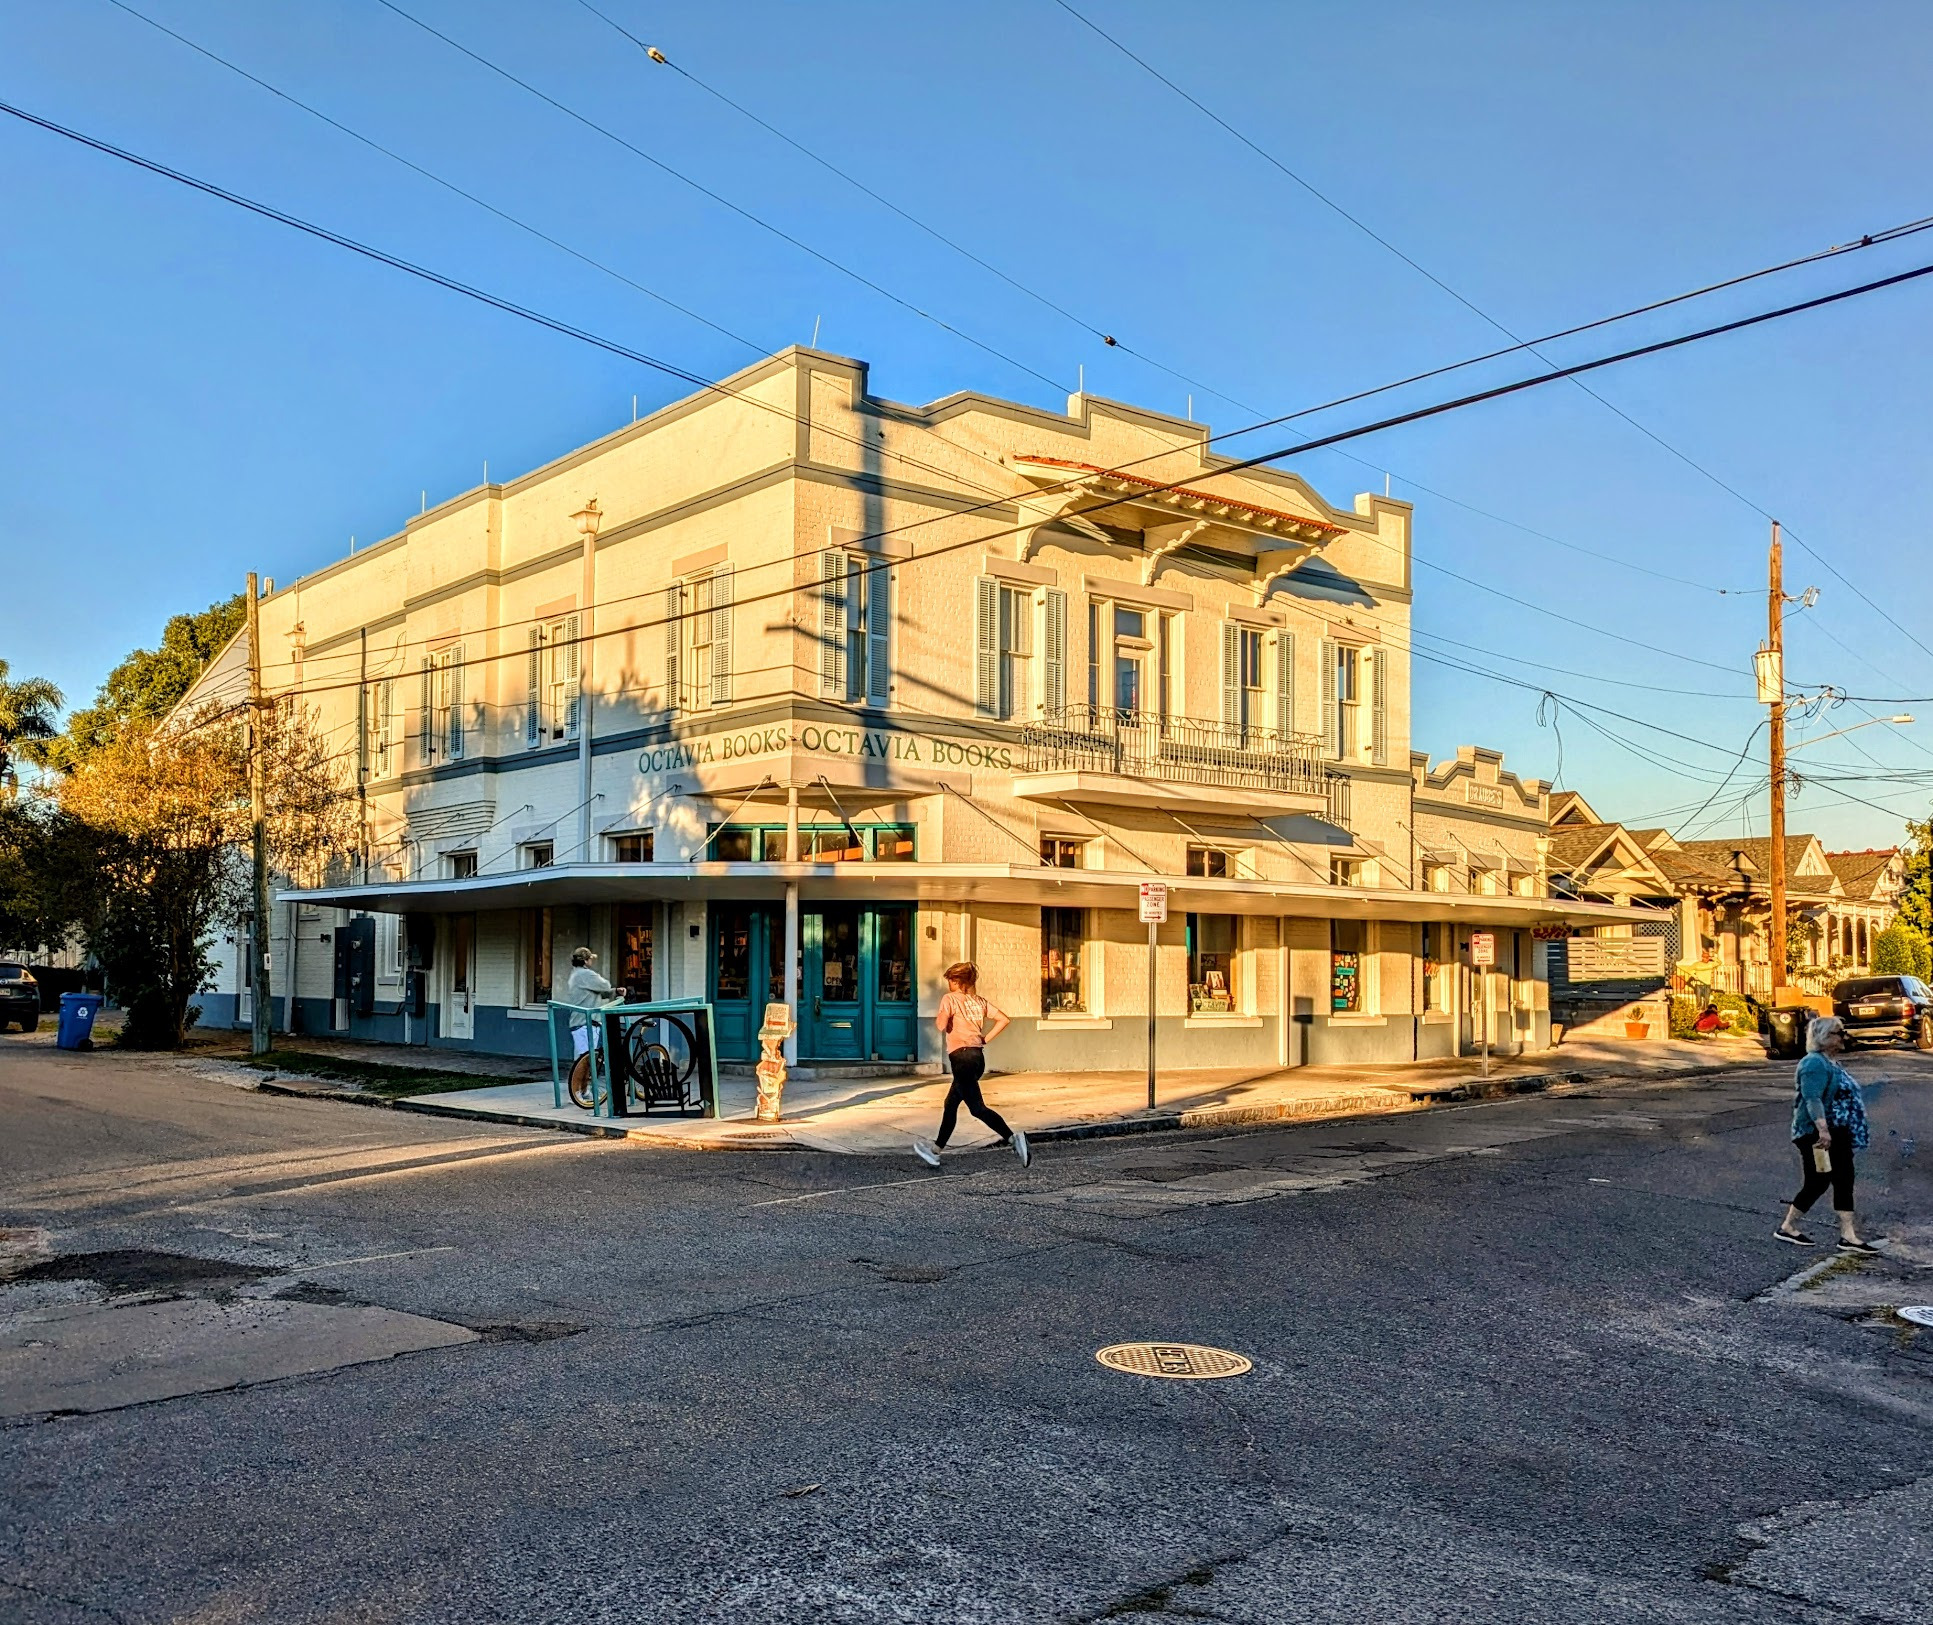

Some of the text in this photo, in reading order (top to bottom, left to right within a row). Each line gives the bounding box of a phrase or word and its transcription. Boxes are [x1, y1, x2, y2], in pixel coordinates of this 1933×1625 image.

[638, 727, 787, 775] OCTAVIA BOOKS
[801, 726, 1012, 770] OCTAVIA BOOKS
[826, 976, 843, 985] OPEN
[1155, 1348, 1192, 1373] SEER
